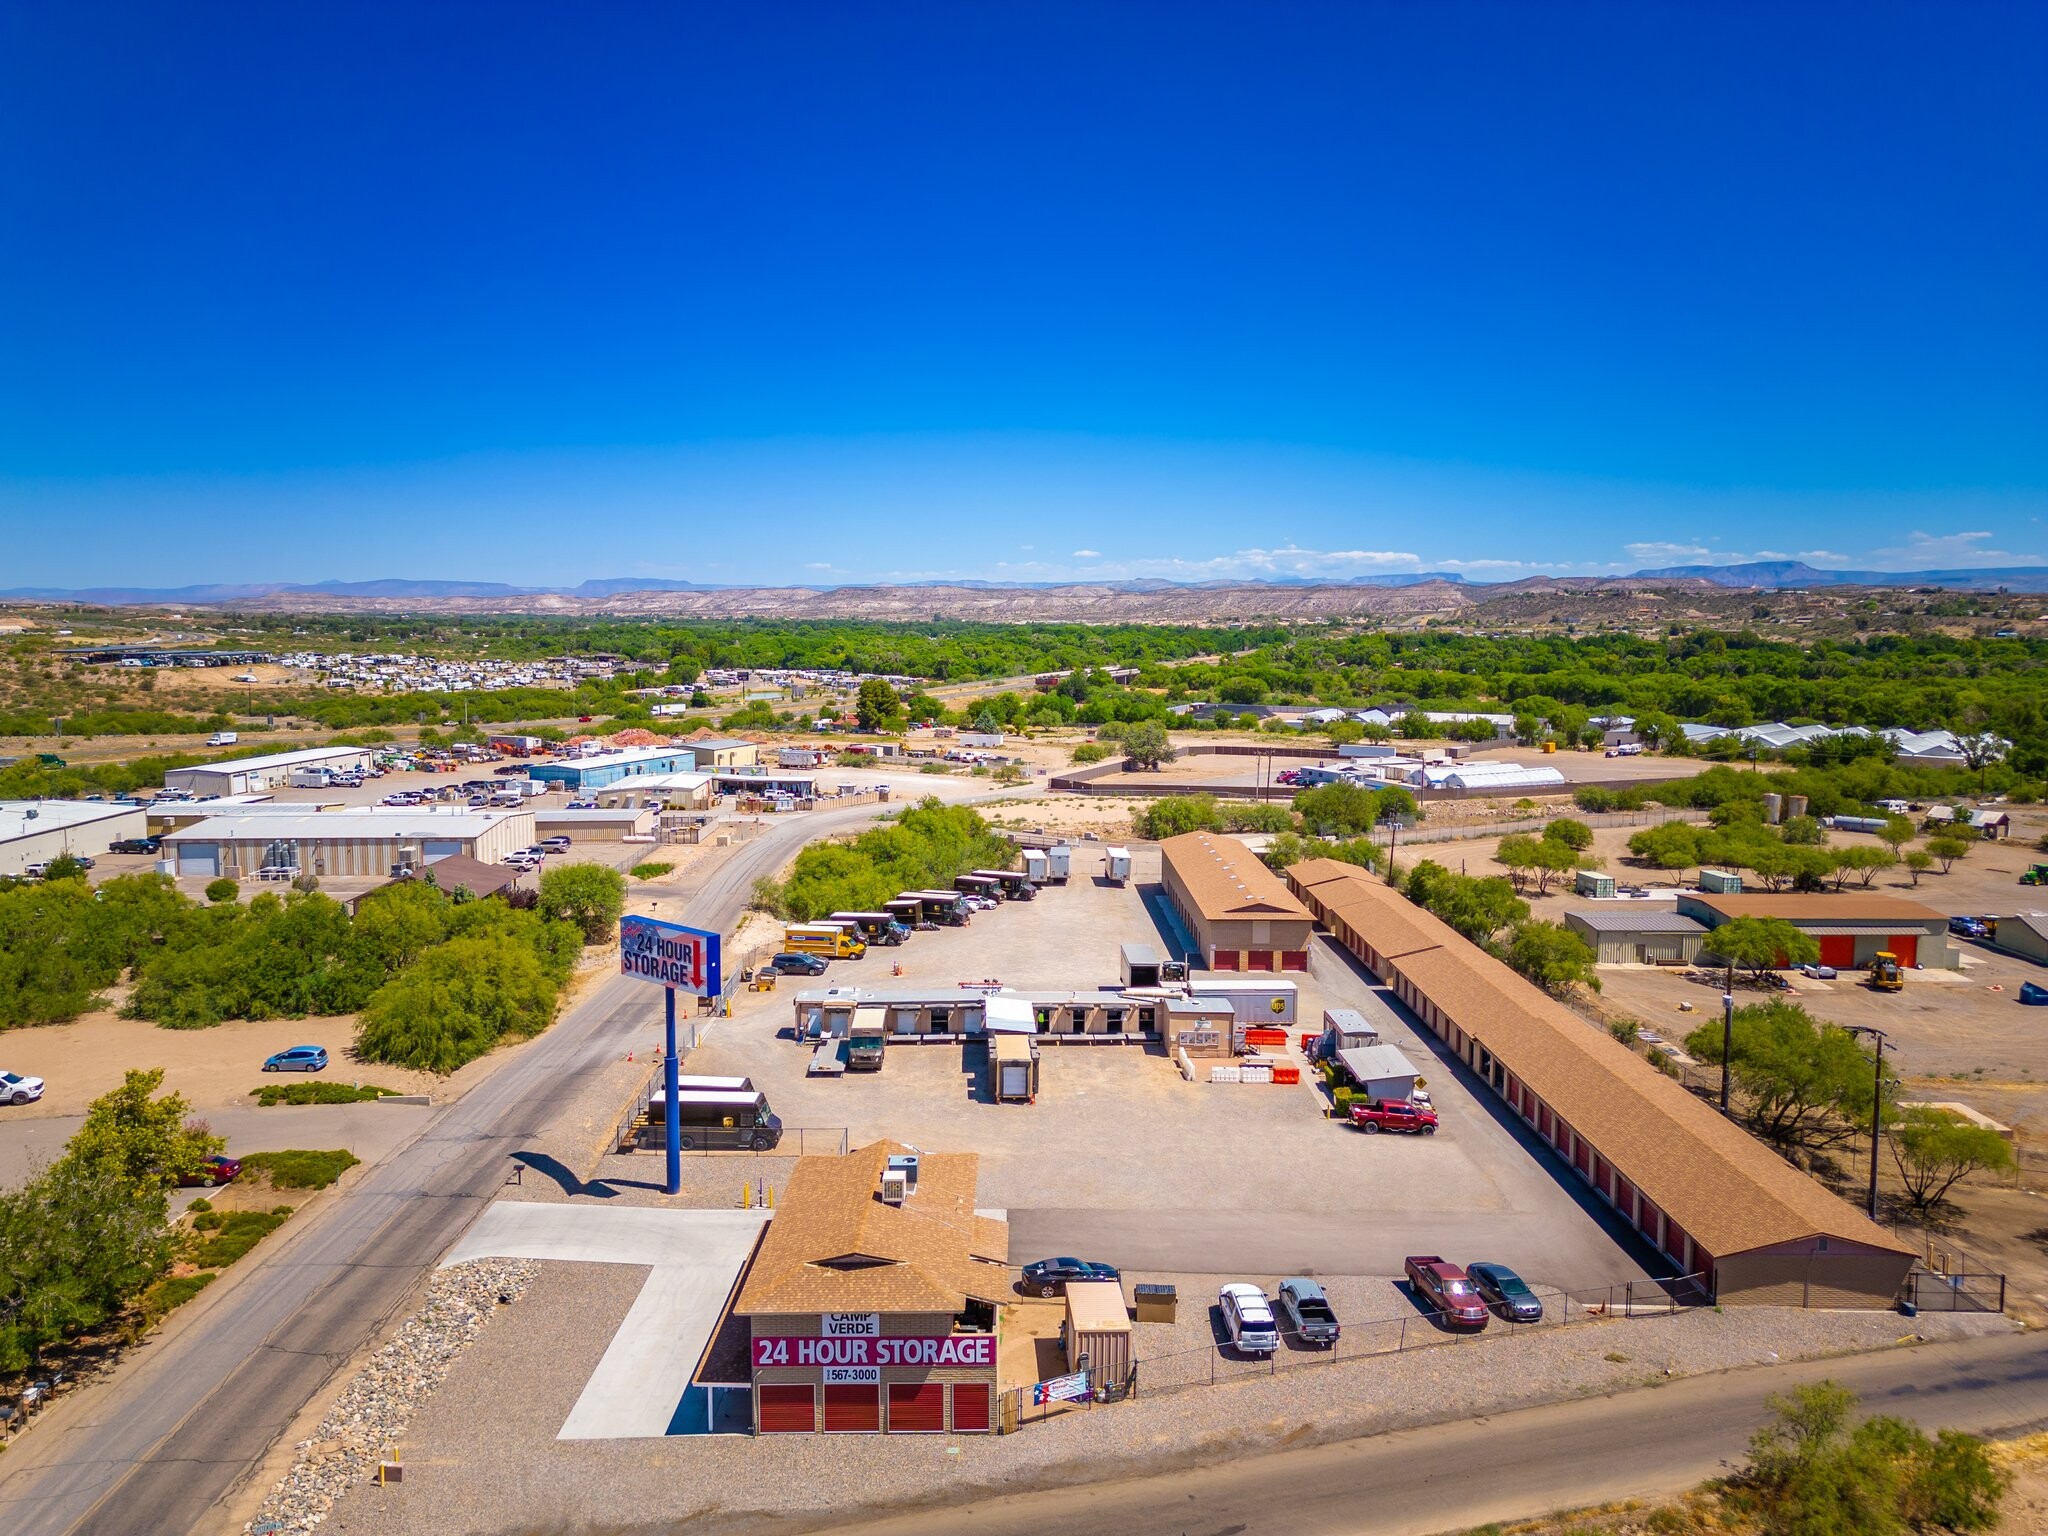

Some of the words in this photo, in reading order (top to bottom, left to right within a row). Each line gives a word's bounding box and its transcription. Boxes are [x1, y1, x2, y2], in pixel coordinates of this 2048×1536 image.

[637, 933, 653, 954] 24
[657, 939, 692, 964] HOUR
[624, 950, 689, 986] STORAGE
[830, 1313, 871, 1322] CAMP
[829, 1323, 873, 1334] VERDE
[759, 1340, 789, 1364] 24
[798, 1339, 868, 1364] HOUR
[876, 1339, 990, 1364] STORAGE
[831, 1369, 877, 1380] 567-3000
